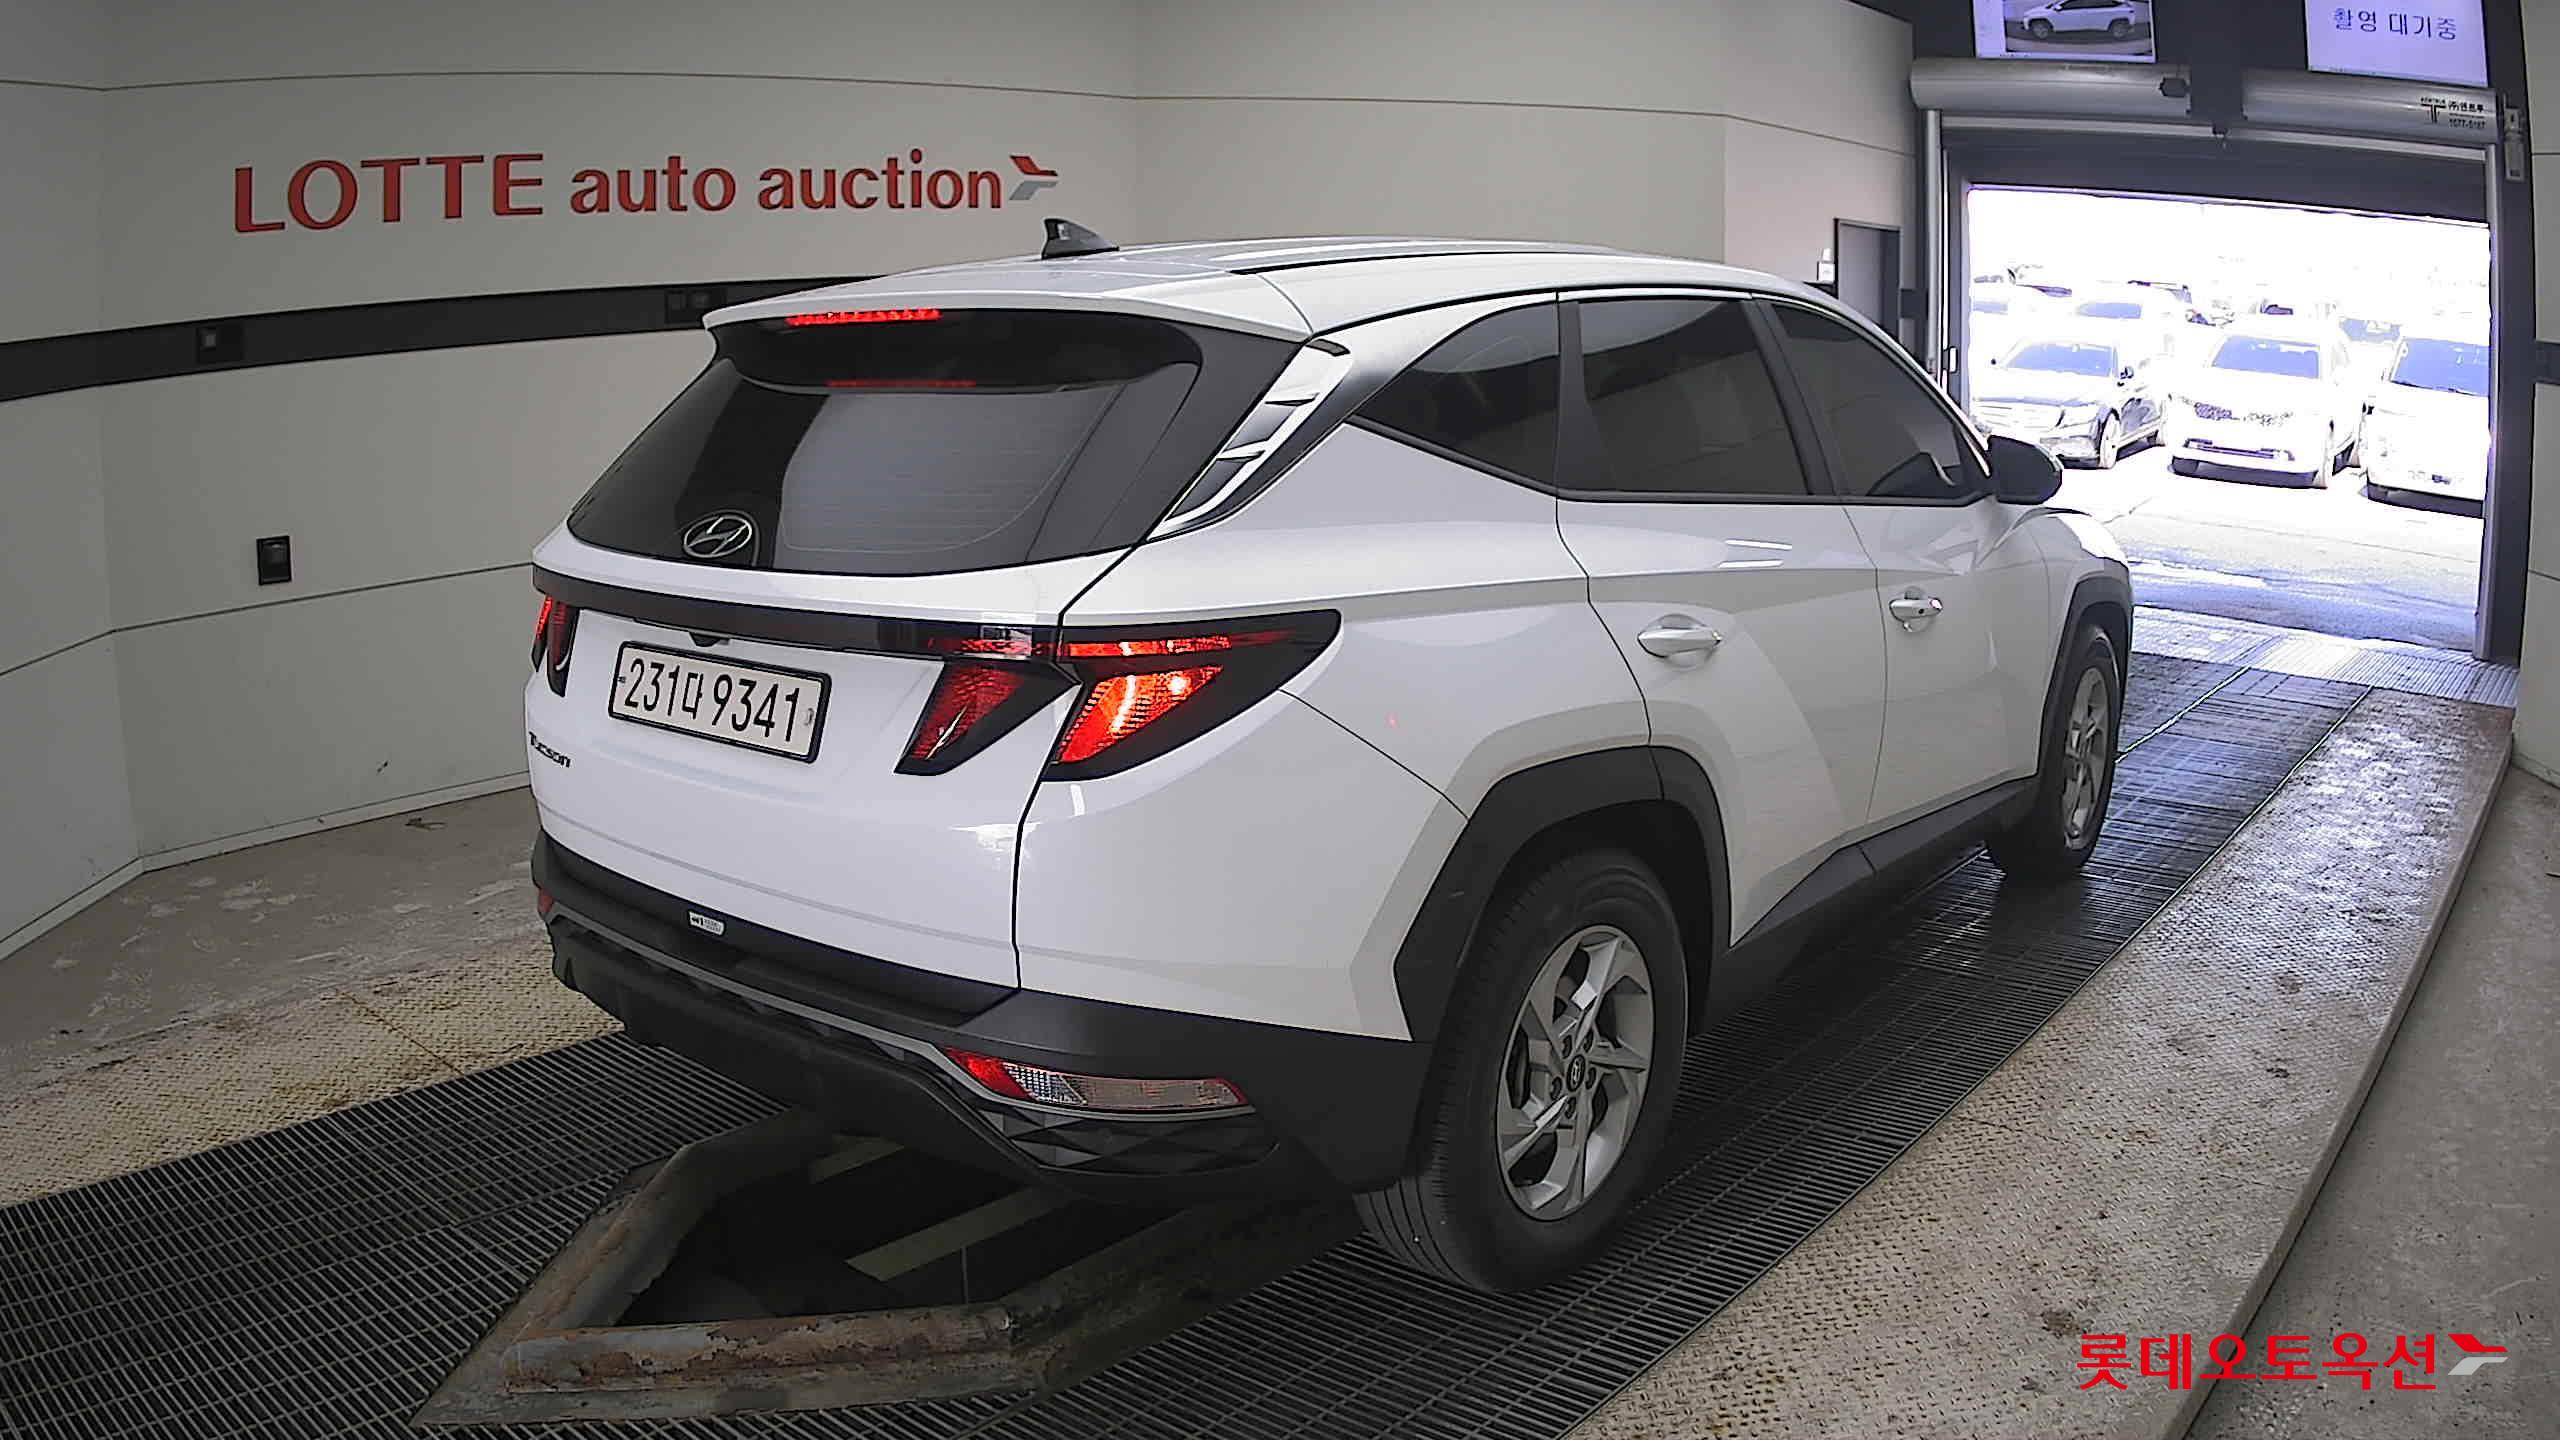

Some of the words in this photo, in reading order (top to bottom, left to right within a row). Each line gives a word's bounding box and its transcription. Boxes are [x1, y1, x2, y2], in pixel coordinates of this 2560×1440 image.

[2334, 8, 2377, 32] 촬영
[2388, 13, 2457, 40] 대기중
[235, 153, 544, 234] LOTTE
[570, 155, 738, 214] auto
[758, 148, 1002, 211] auction
[711, 674, 800, 742] 9341
